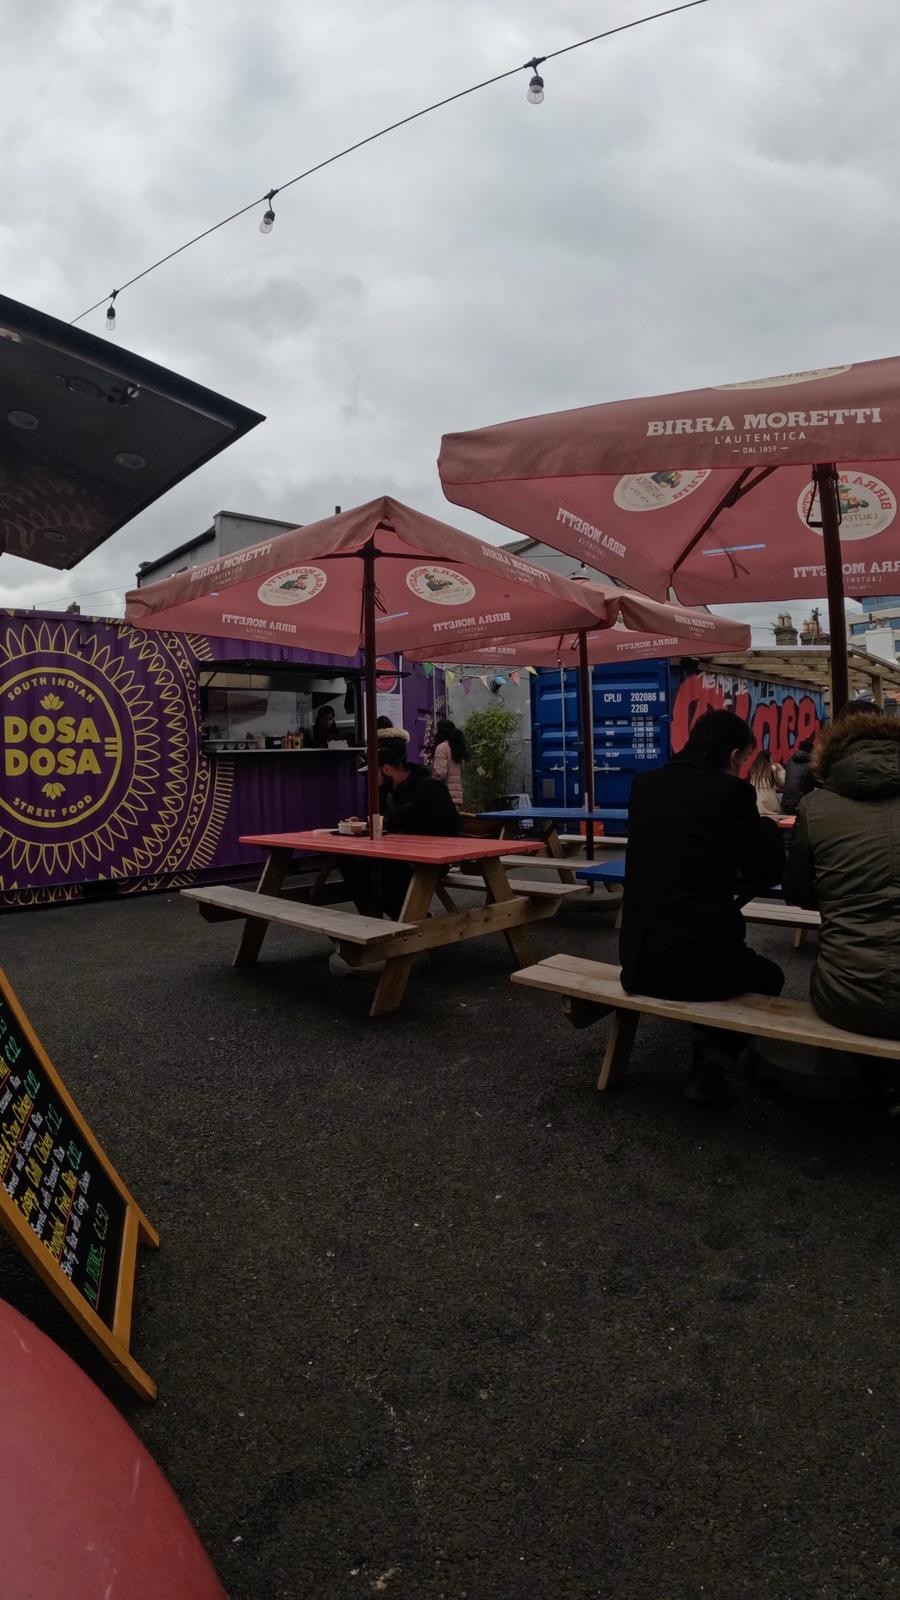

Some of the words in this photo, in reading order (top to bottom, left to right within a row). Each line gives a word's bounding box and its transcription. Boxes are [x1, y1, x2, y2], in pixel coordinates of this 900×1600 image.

[646, 416, 735, 437] BIRRA
[743, 407, 882, 430] MORETTI
[714, 431, 807, 445] L'AUTENTICA
[742, 446, 757, 454] DAL
[759, 445, 777, 453] 1859
[190, 562, 220, 582] BIRRA
[223, 544, 273, 572] MORETTI
[7, 677, 47, 701] SOUTH
[52, 677, 95, 704] INDIAN
[604, 693, 622, 703] CPLU
[630, 692, 657, 702] 202086
[4, 715, 102, 744] DOSA
[4, 748, 102, 776] DOSA
[13, 797, 57, 818] STREET
[62, 794, 93, 816] FOOD
[12, 1093, 33, 1124] Chicken
[33, 1132, 54, 1164] Chicken
